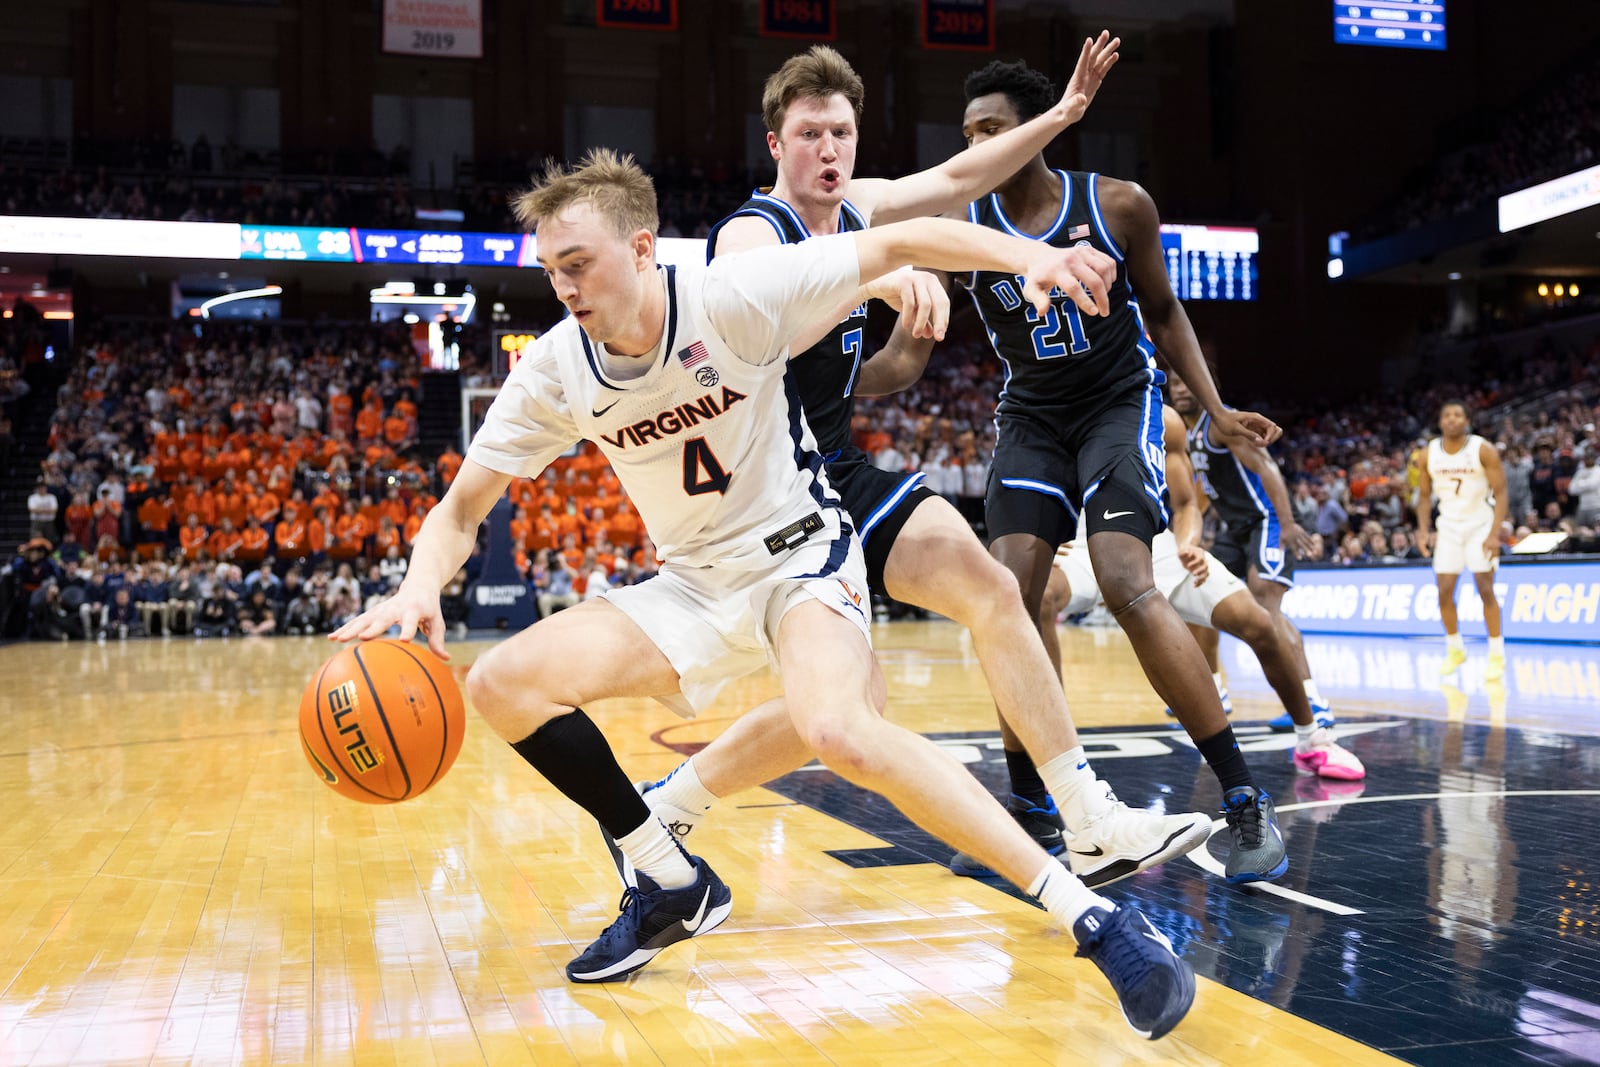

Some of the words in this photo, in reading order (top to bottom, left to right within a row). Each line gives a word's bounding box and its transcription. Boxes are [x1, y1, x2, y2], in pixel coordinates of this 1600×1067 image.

[411, 30, 455, 50] 2019
[933, 9, 984, 34] 2019
[1025, 300, 1091, 360] 21
[841, 327, 863, 399] 7
[600, 385, 748, 450] VIRGINIA
[682, 436, 733, 496] 4
[1450, 477, 1462, 496] 7
[1362, 583, 1412, 620] THE
[327, 683, 380, 775] ELITE
